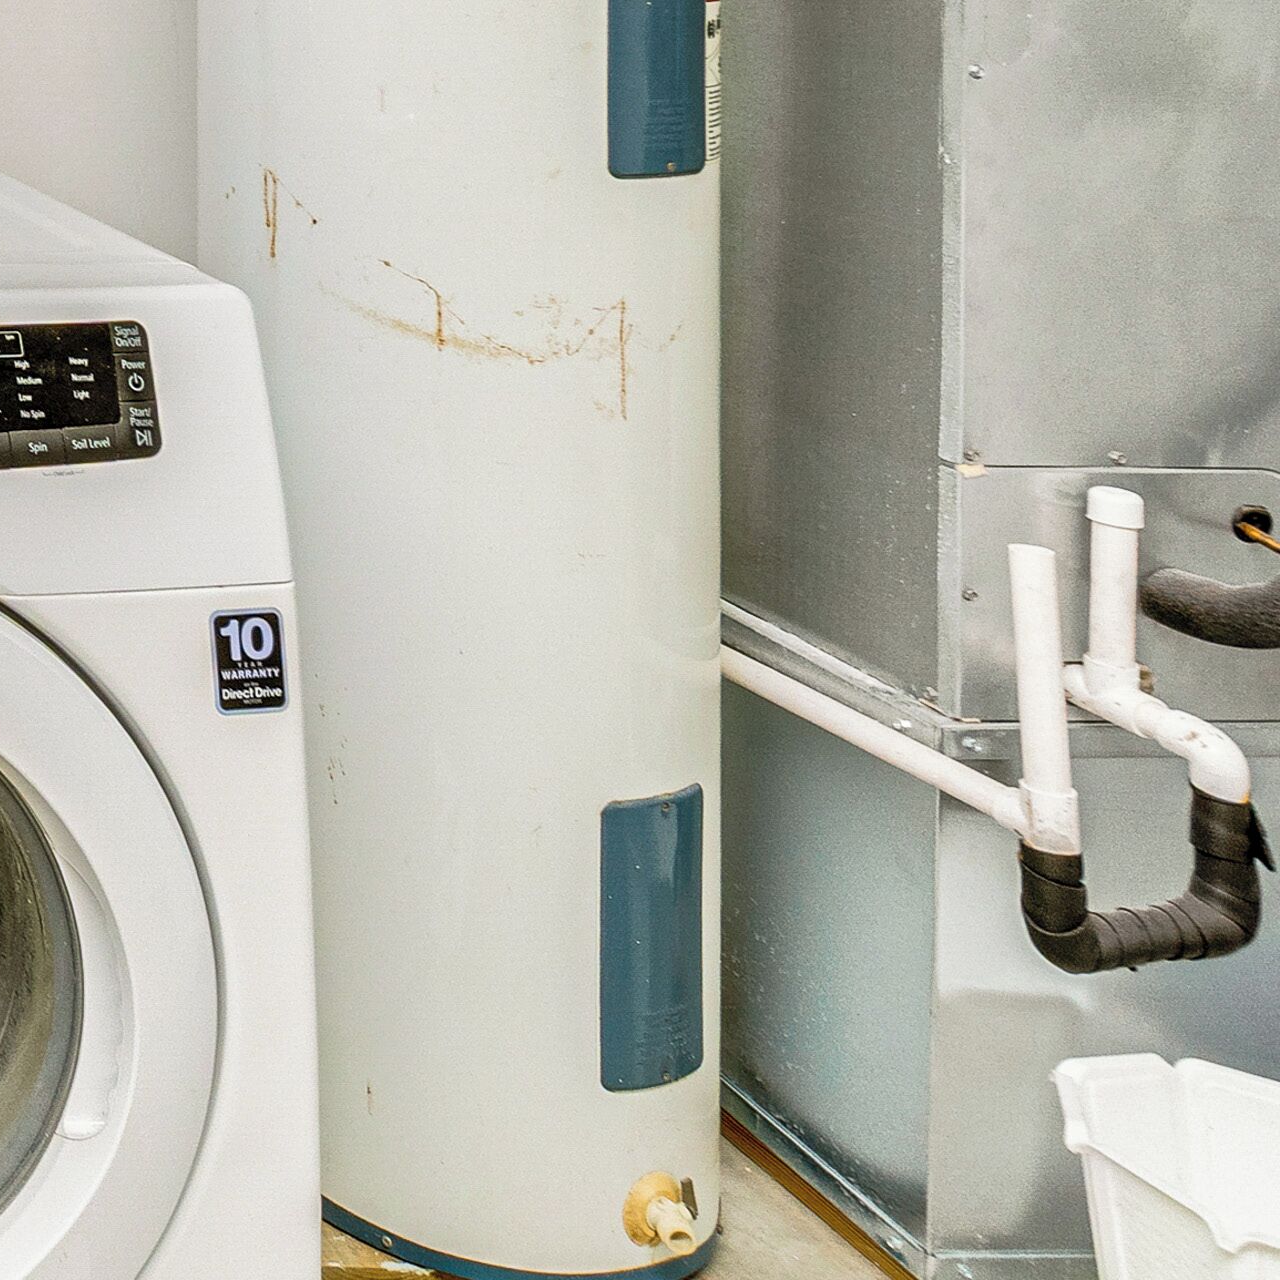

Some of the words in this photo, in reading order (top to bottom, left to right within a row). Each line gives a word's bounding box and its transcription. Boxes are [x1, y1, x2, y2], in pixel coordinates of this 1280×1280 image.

[114, 326, 139, 339] Signal
[115, 336, 142, 347] On/Off
[13, 360, 30, 370] High
[68, 357, 89, 367] Heavy
[121, 359, 146, 370] Power
[16, 376, 43, 385] Medium
[70, 373, 95, 382] Normal
[18, 393, 33, 402] Low
[73, 390, 90, 401] Light
[20, 410, 30, 418] No
[31, 410, 45, 419] Spin
[129, 407, 151, 418] Start/
[130, 417, 154, 428] Pause
[28, 442, 48, 455] Spin
[71, 439, 87, 450] Soil
[89, 437, 111, 449] Level
[220, 617, 274, 661] 10
[221, 667, 280, 680] WARRANTY
[222, 687, 254, 700] Direct
[255, 686, 283, 698] Drive
